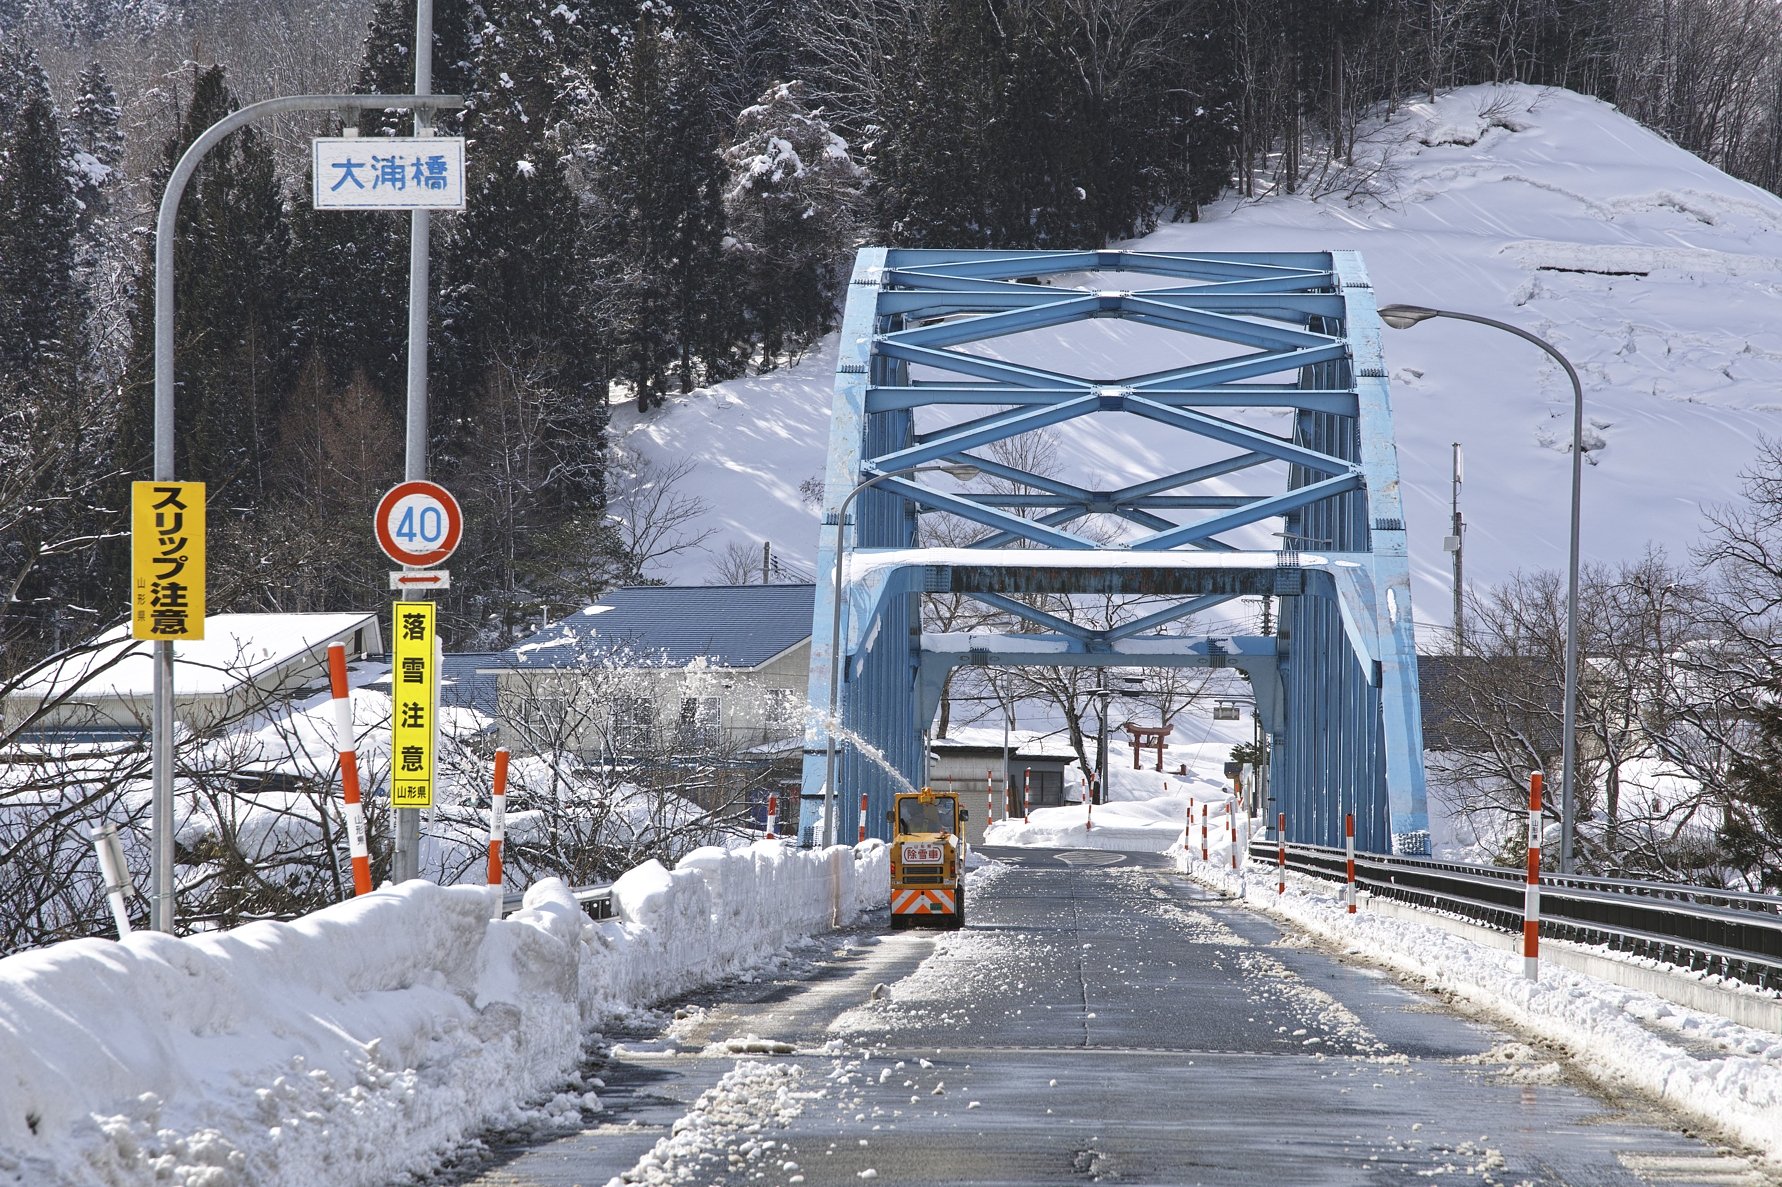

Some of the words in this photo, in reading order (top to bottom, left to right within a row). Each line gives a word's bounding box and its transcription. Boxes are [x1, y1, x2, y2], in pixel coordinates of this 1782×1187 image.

[330, 155, 448, 192] 大浦橋
[396, 506, 442, 542] 40
[150, 487, 189, 635] スリップ注意
[401, 613, 426, 772] 落雪注意
[397, 786, 426, 800] 山形県
[907, 849, 939, 860] 除雪車
